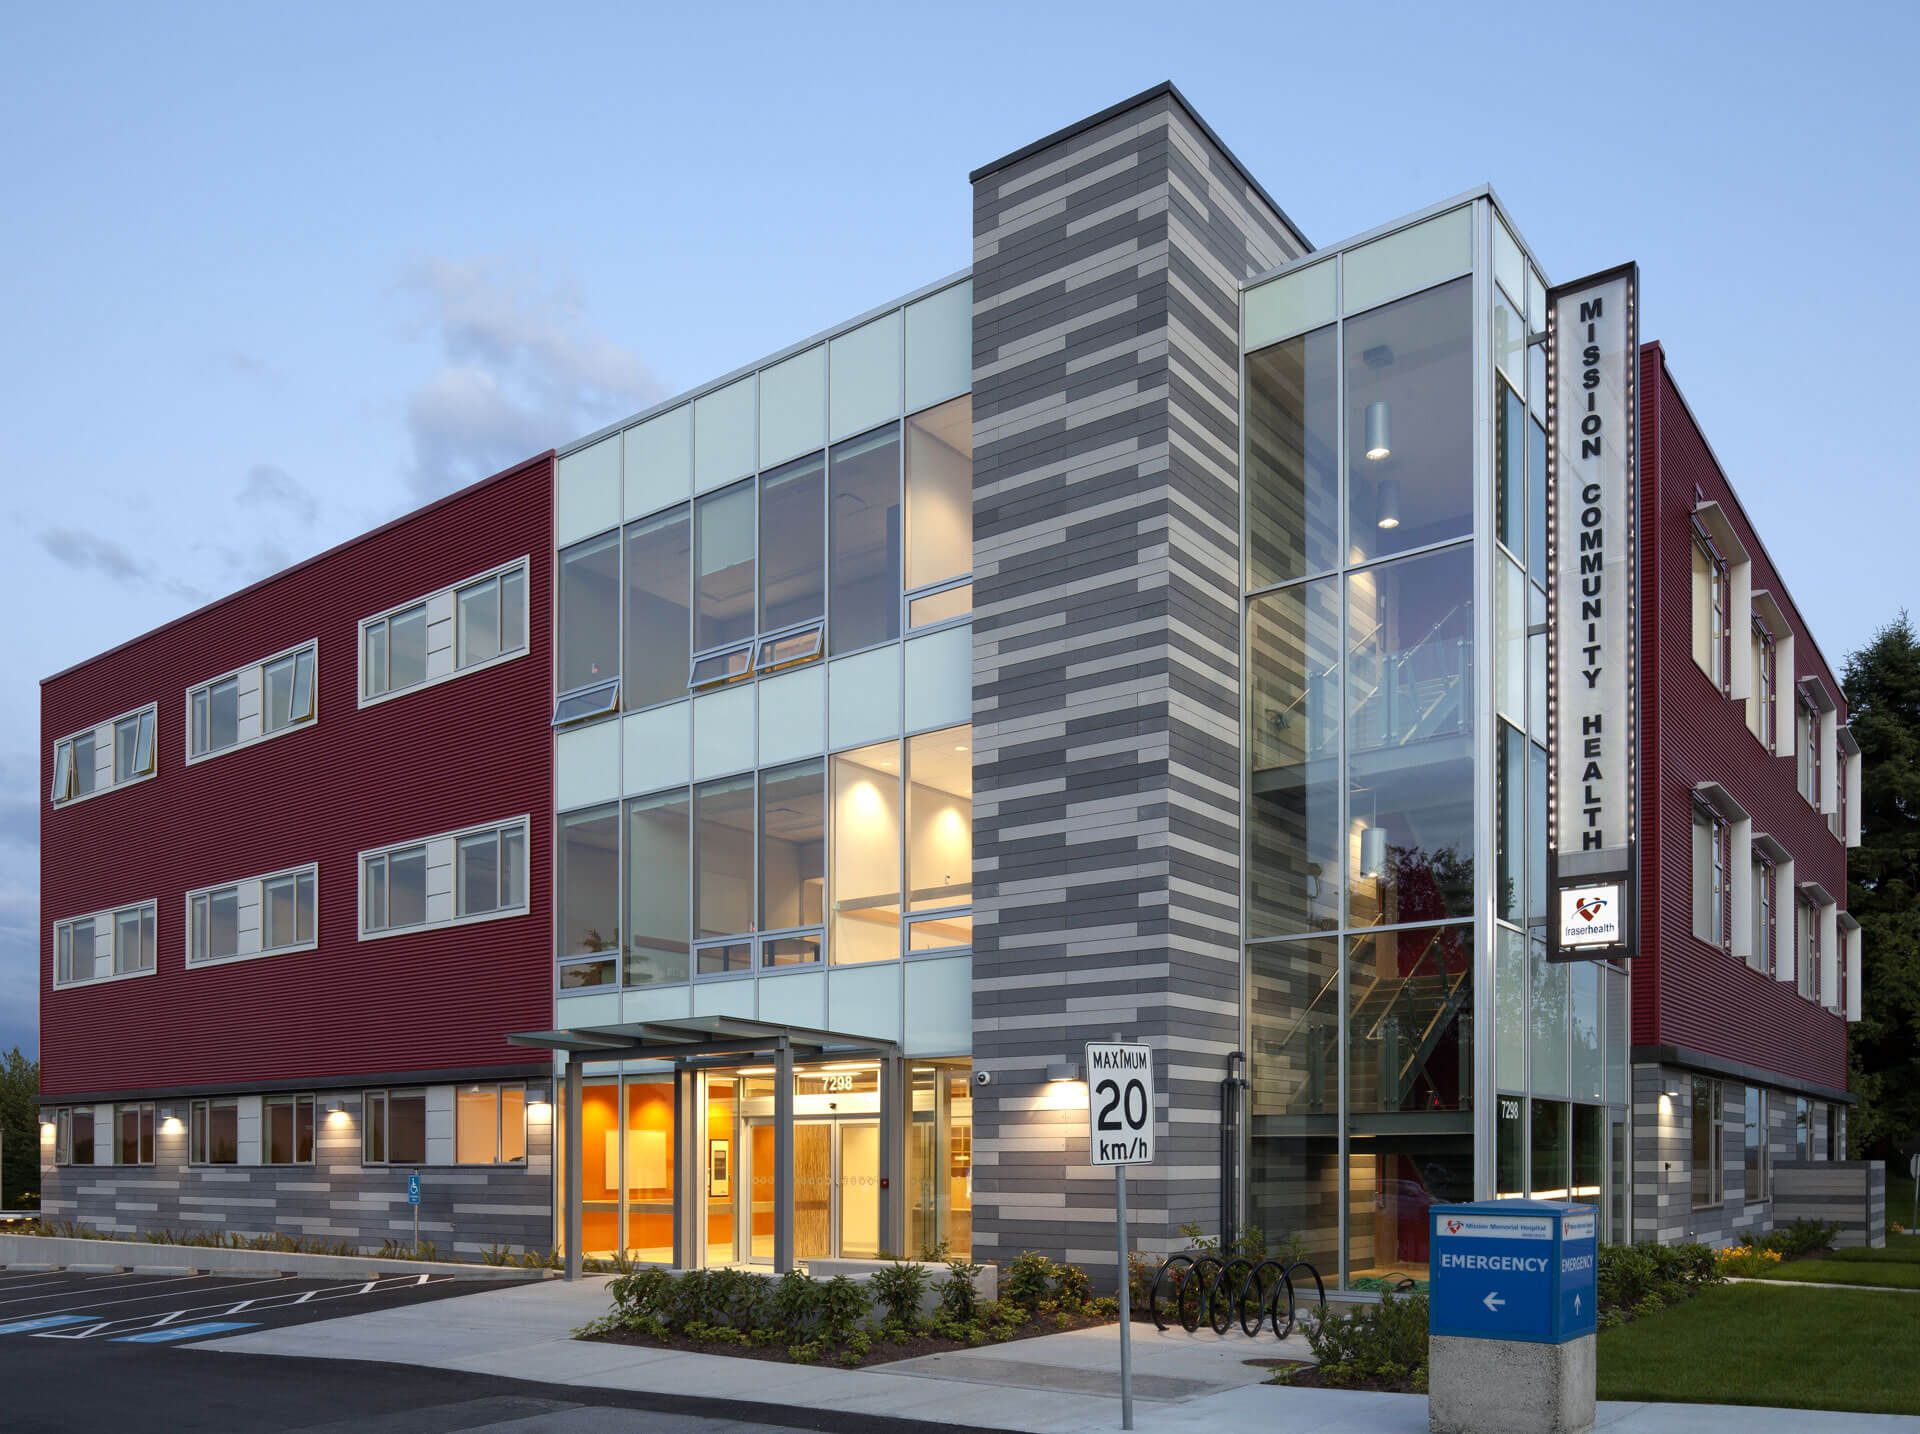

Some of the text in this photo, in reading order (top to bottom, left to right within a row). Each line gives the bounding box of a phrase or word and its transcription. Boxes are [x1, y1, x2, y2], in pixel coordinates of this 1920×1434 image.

[1580, 297, 1603, 850] MISSION COMMUNITY HEALTH
[1565, 923, 1615, 936] fraserhealth
[1093, 1051, 1147, 1069] MAXIMUM
[821, 1075, 853, 1091] 7298
[1096, 1079, 1147, 1131] 20
[1502, 1100, 1519, 1119] 7298
[1100, 1137, 1147, 1160] km/h
[1441, 1254, 1549, 1273] EMERGENCY
[1561, 1255, 1594, 1272] EMERGENCY
